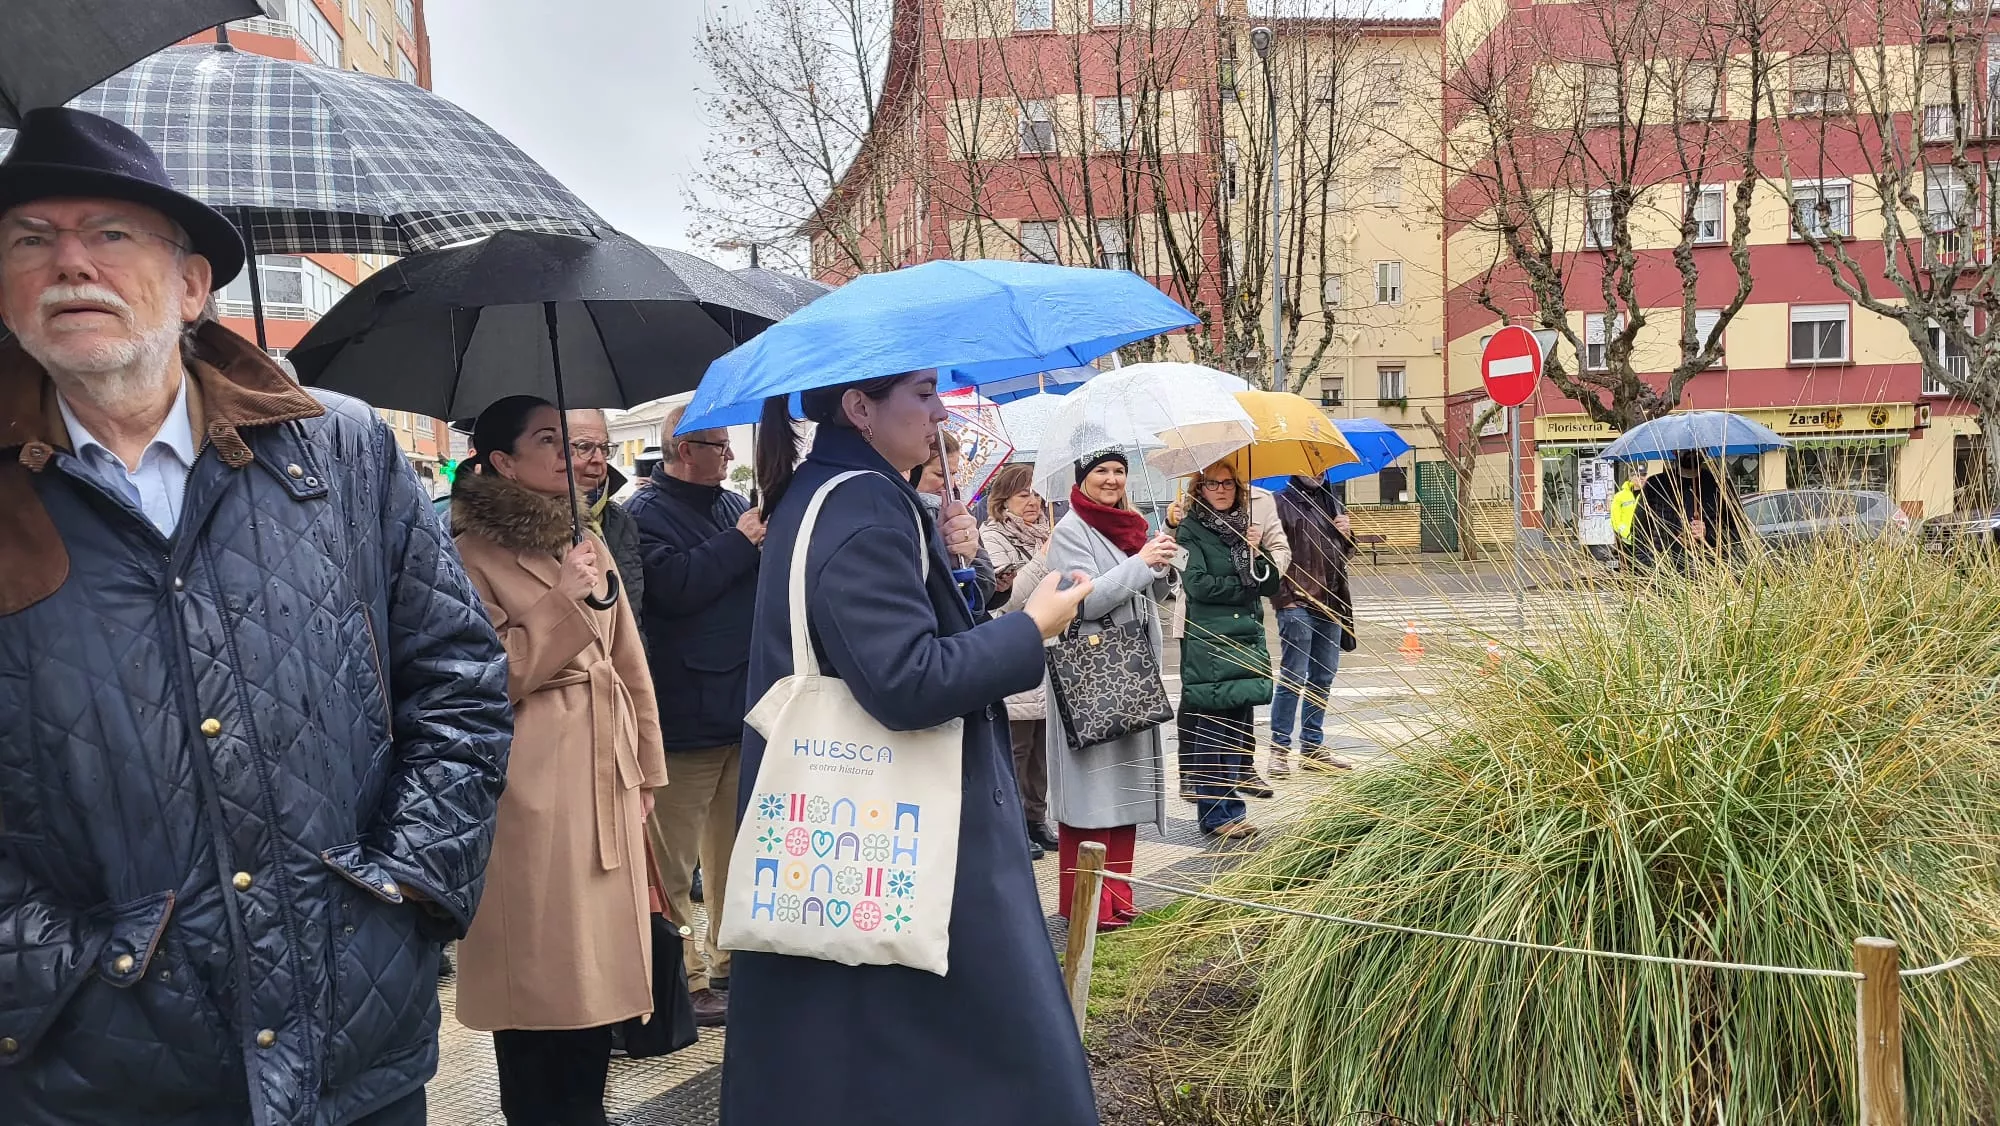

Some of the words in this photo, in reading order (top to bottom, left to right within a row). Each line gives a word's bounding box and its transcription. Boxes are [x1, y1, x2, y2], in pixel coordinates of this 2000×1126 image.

[794, 739, 892, 764] HUESCA
[819, 764, 837, 772] otra
[839, 765, 874, 776] historia
